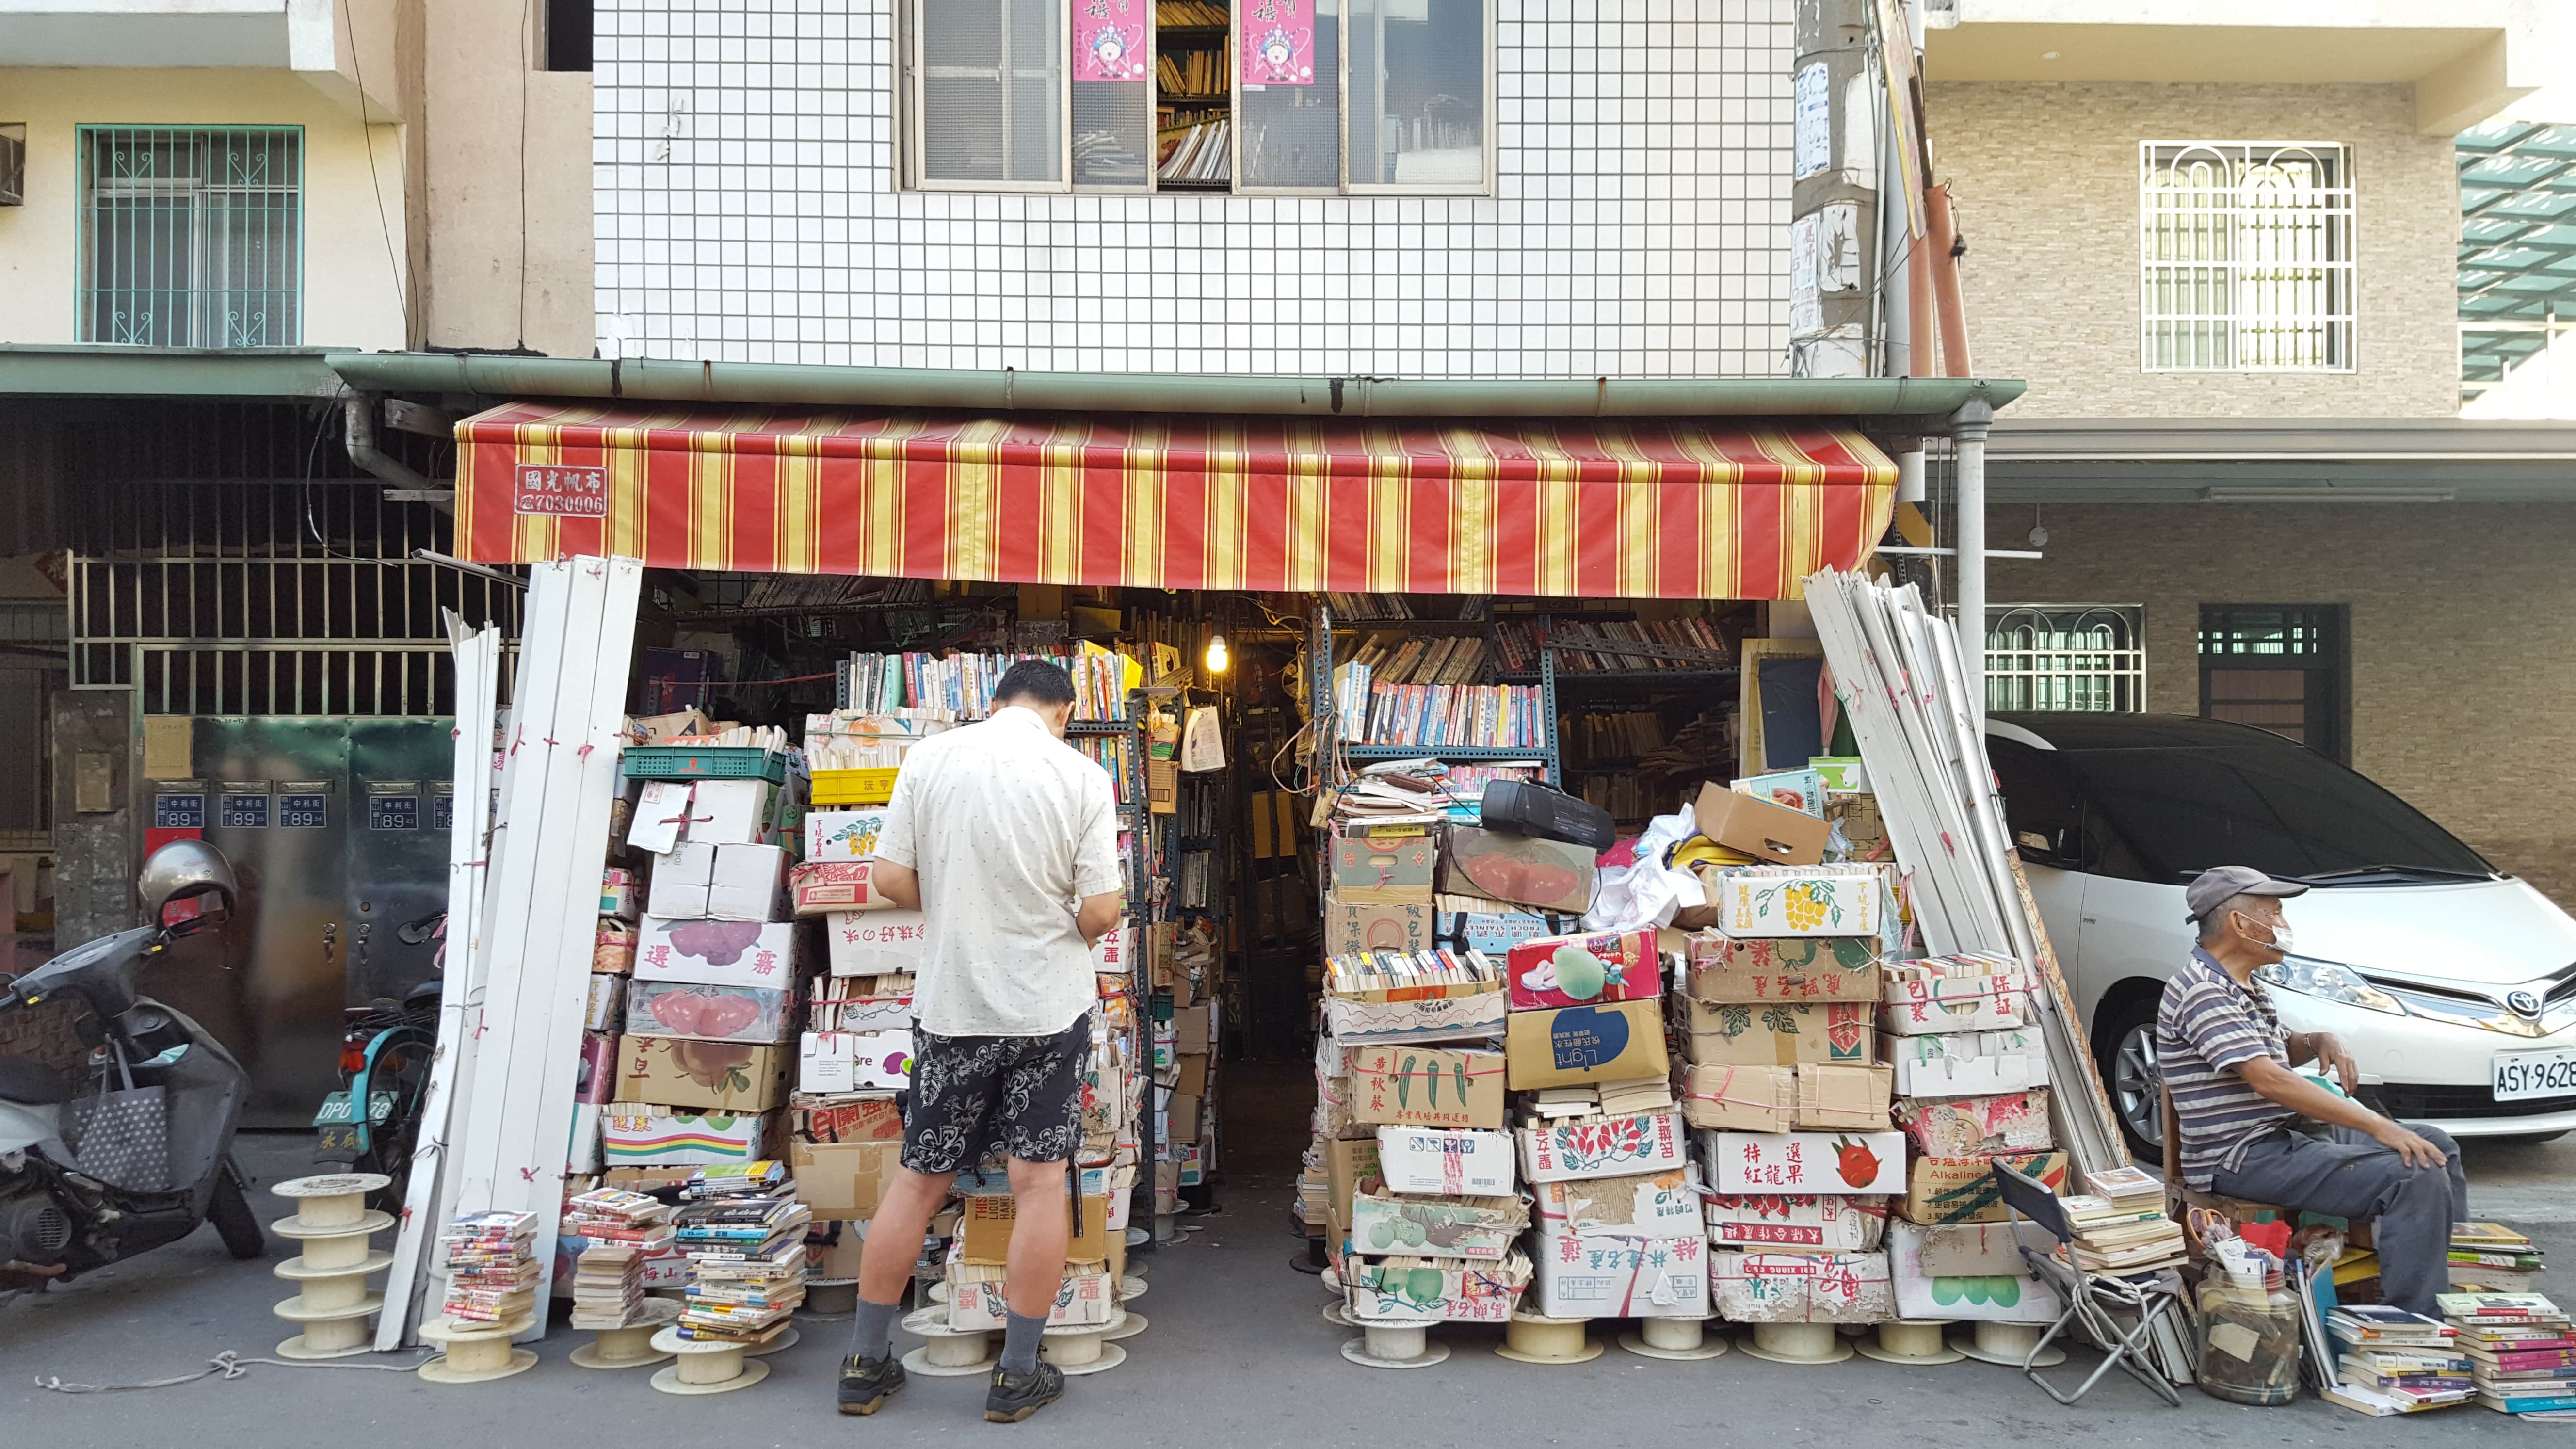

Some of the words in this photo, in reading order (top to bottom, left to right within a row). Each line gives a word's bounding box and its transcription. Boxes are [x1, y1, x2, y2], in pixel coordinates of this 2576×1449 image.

[525, 470, 601, 494] 國光帆布
[536, 495, 603, 513] 7030006
[168, 813, 190, 826] 89
[233, 813, 255, 826] 89
[291, 812, 313, 826] 89
[383, 815, 404, 828] 89
[1556, 1048, 1598, 1072] Light
[1369, 1056, 1388, 1112] 黃秋葵
[1744, 1164, 1803, 1185] 紅龍果
[1930, 1170, 1982, 1180] Alkaline
[989, 1196, 999, 1220] LIQUI
